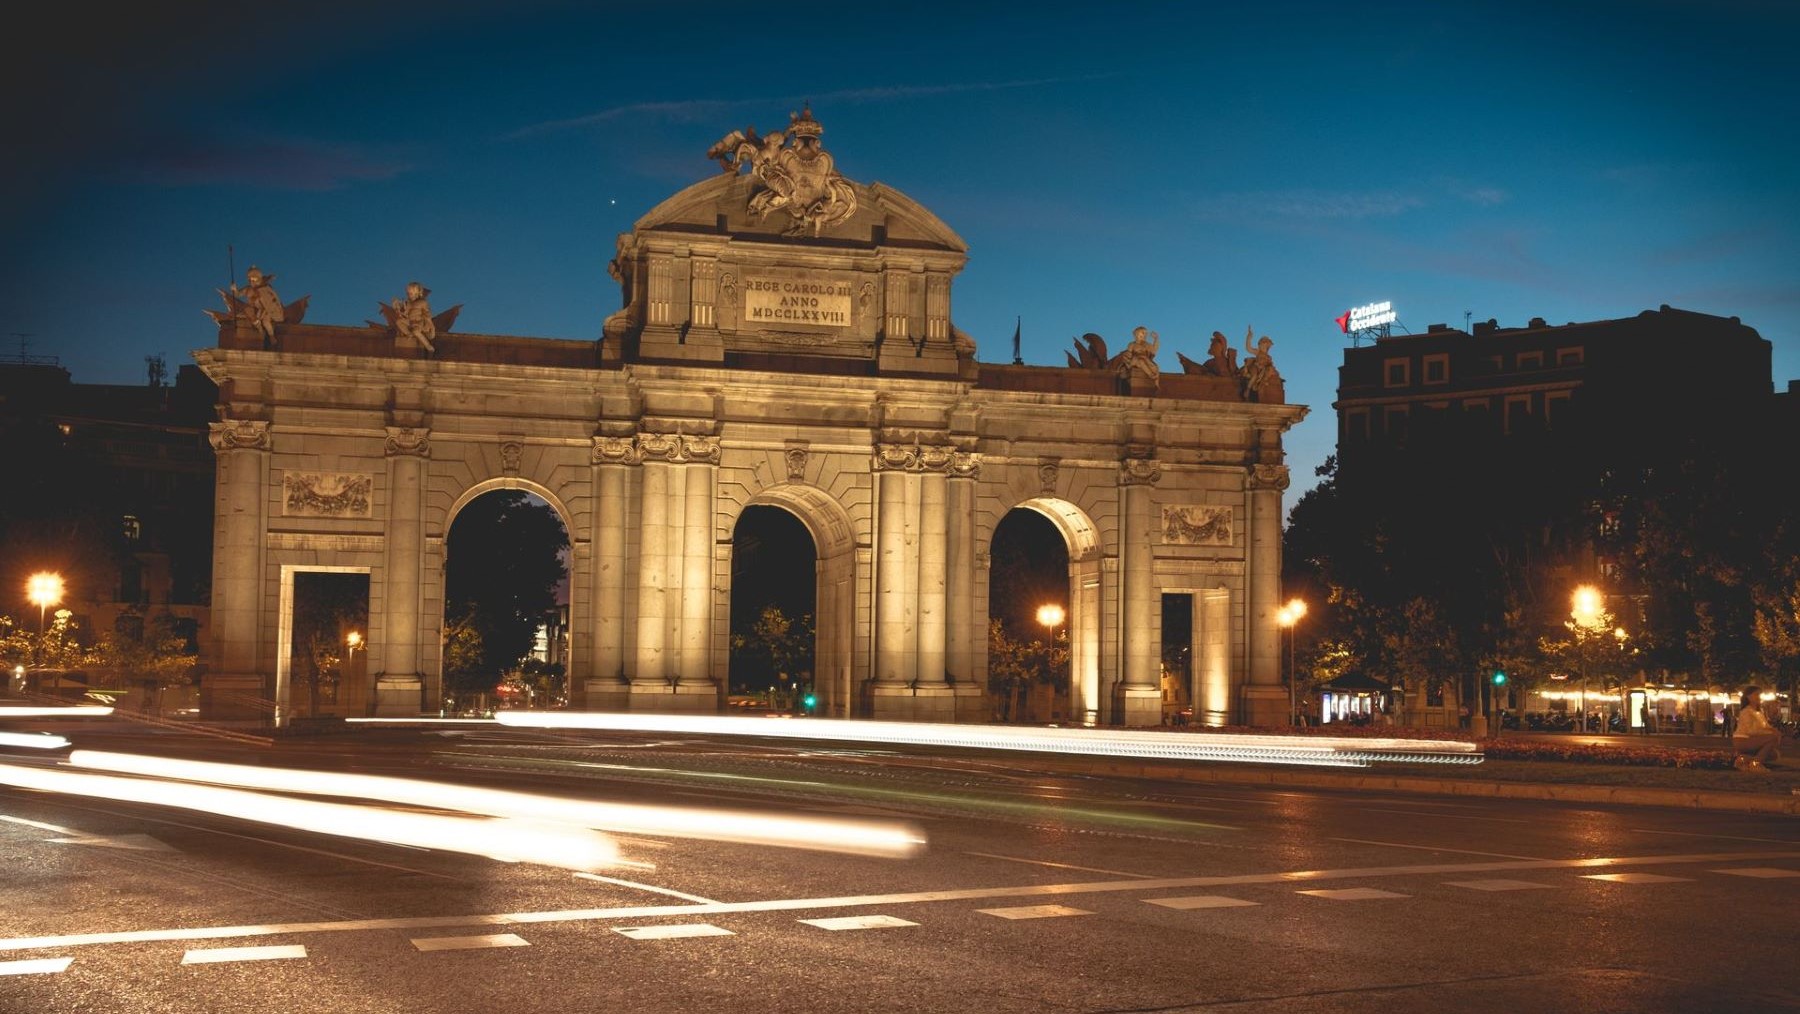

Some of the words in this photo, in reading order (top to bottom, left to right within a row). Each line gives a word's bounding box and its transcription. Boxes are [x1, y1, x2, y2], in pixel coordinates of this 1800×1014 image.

[746, 281, 779, 292] REGE
[783, 283, 834, 296] CAROLO
[838, 287, 851, 296] III
[780, 296, 818, 307] ANNO
[752, 307, 844, 322] MDCCLXXVIII
